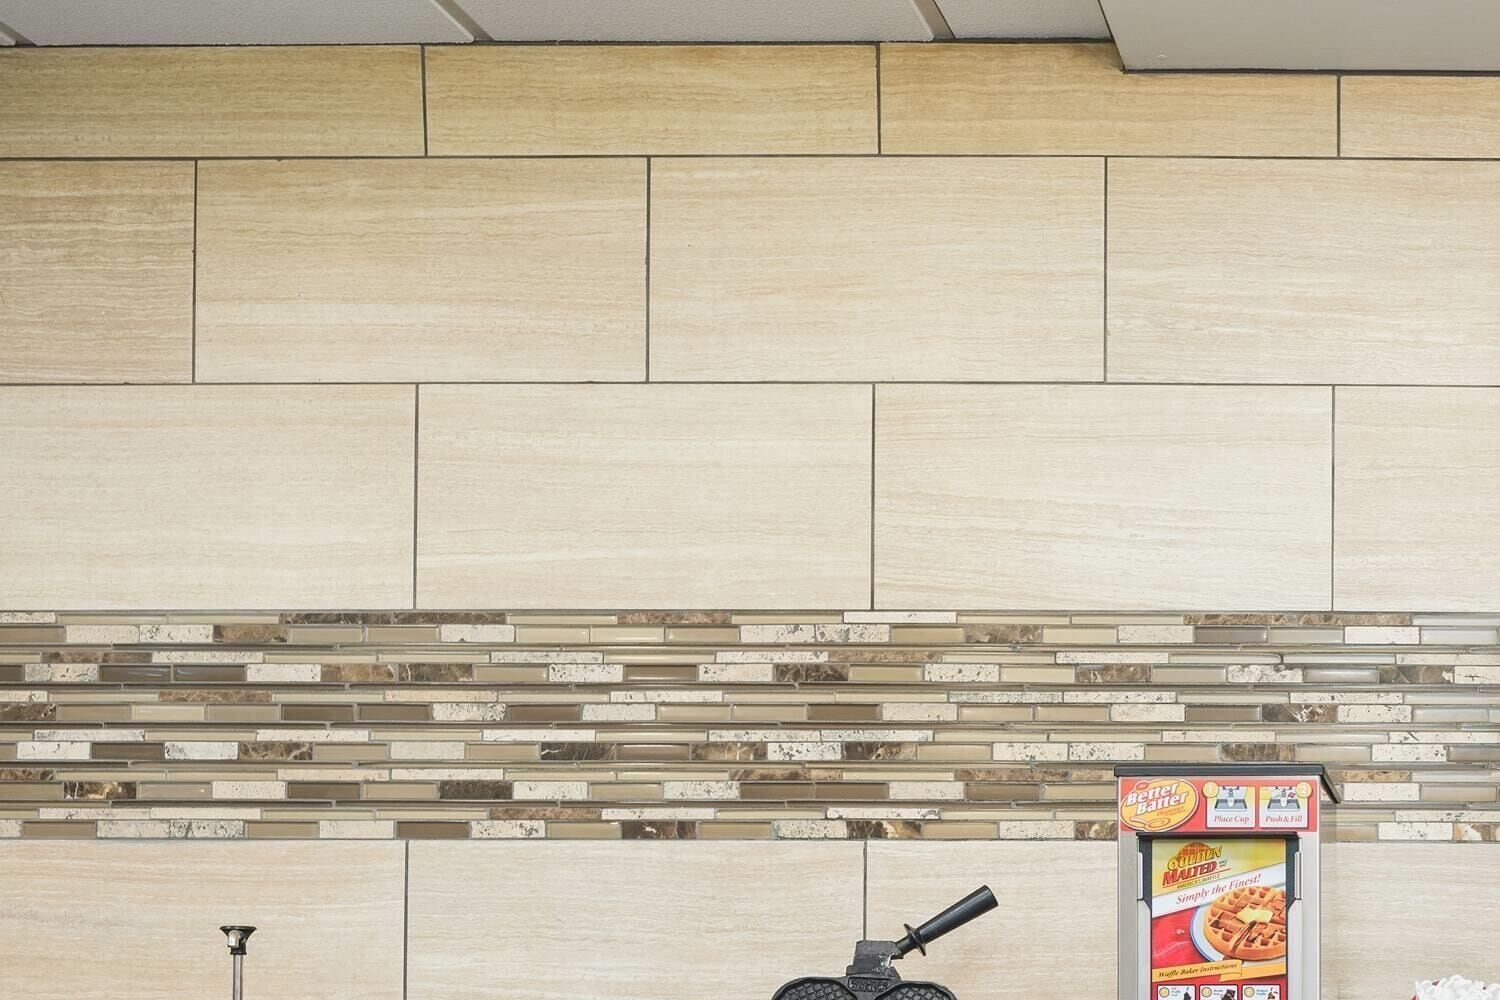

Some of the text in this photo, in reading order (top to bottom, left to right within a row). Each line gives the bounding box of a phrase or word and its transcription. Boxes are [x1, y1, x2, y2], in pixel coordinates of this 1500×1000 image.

[1126, 782, 1180, 807] Better
[1136, 791, 1189, 816] Batter
[1234, 816, 1250, 824] Cup
[1167, 845, 1222, 871] GOLDEN
[1162, 861, 1217, 886] MALTED
[1176, 873, 1261, 904] Simply the Finest!
[1159, 963, 1237, 978] Waffle Baker Instructions
